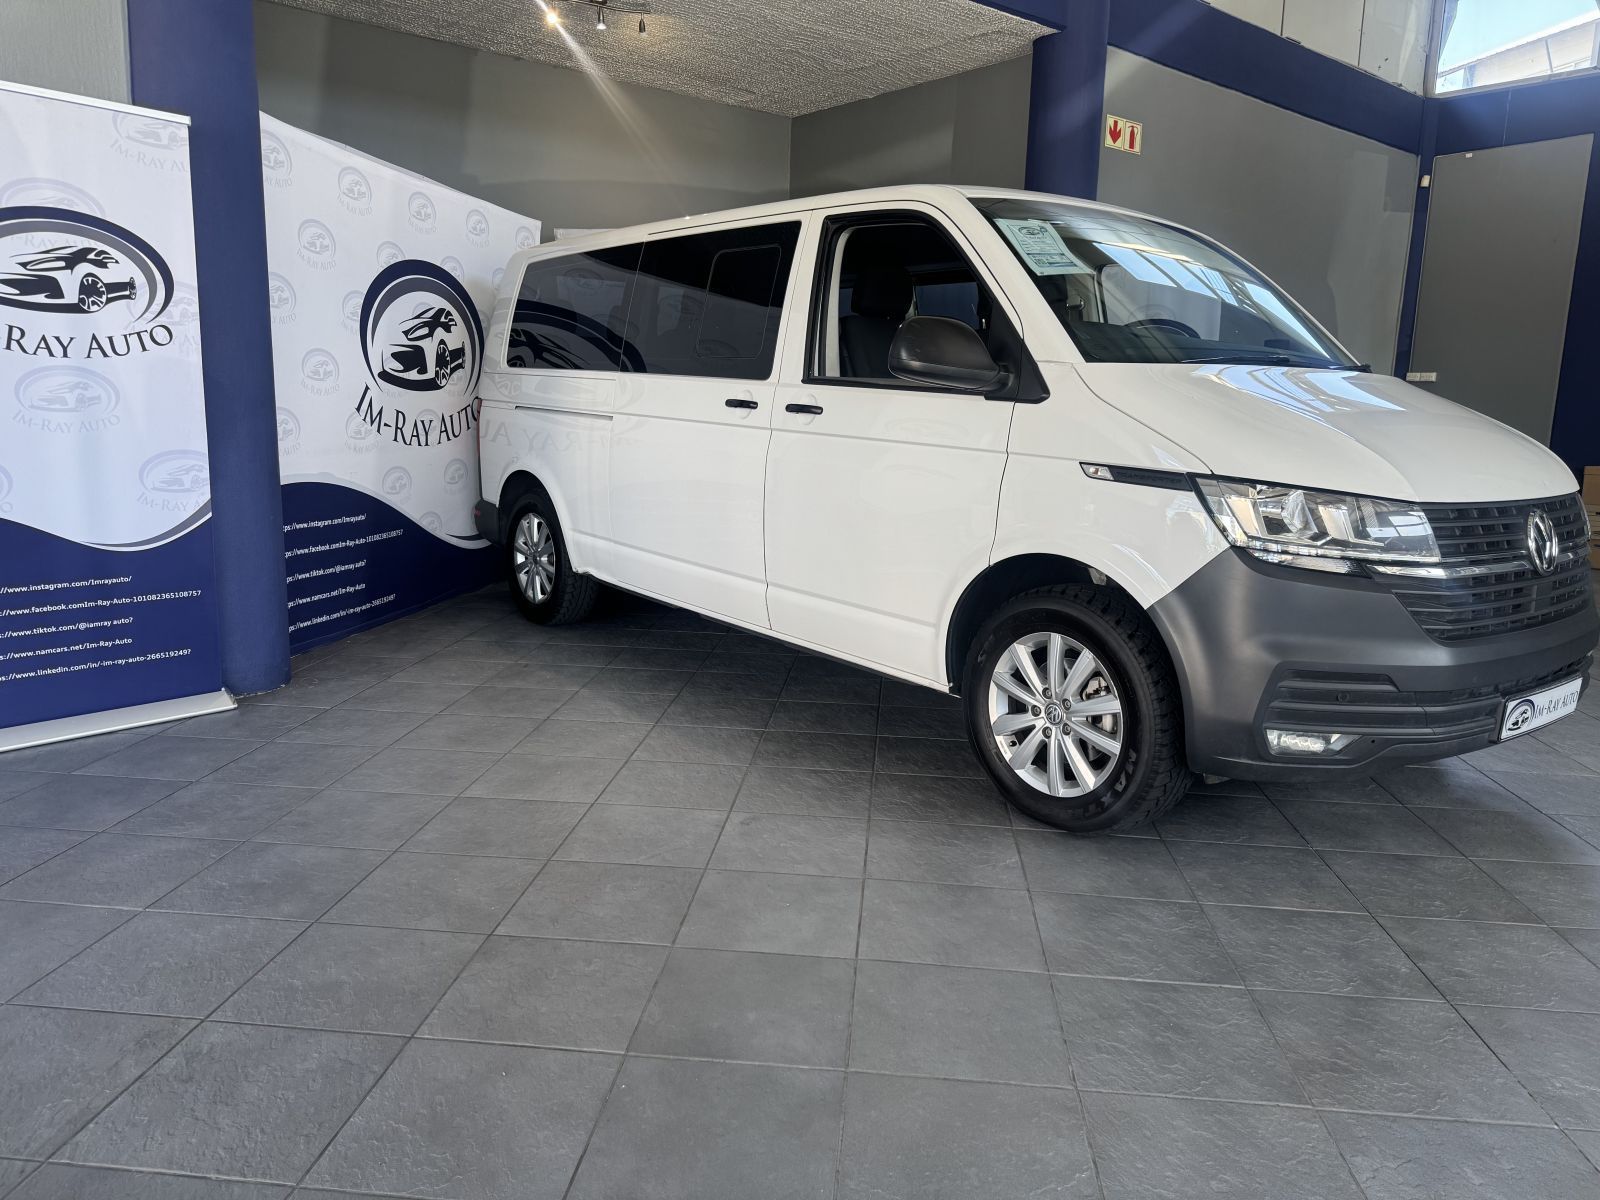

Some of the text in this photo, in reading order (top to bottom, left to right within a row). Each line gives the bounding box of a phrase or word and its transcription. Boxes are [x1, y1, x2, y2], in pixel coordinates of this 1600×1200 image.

[2, 323, 77, 359] RAY
[84, 324, 174, 360] AUTO
[12, 408, 121, 434] IM-RAY AUTO
[355, 381, 434, 447] IM-RAY
[113, 617, 133, 626] auto?
